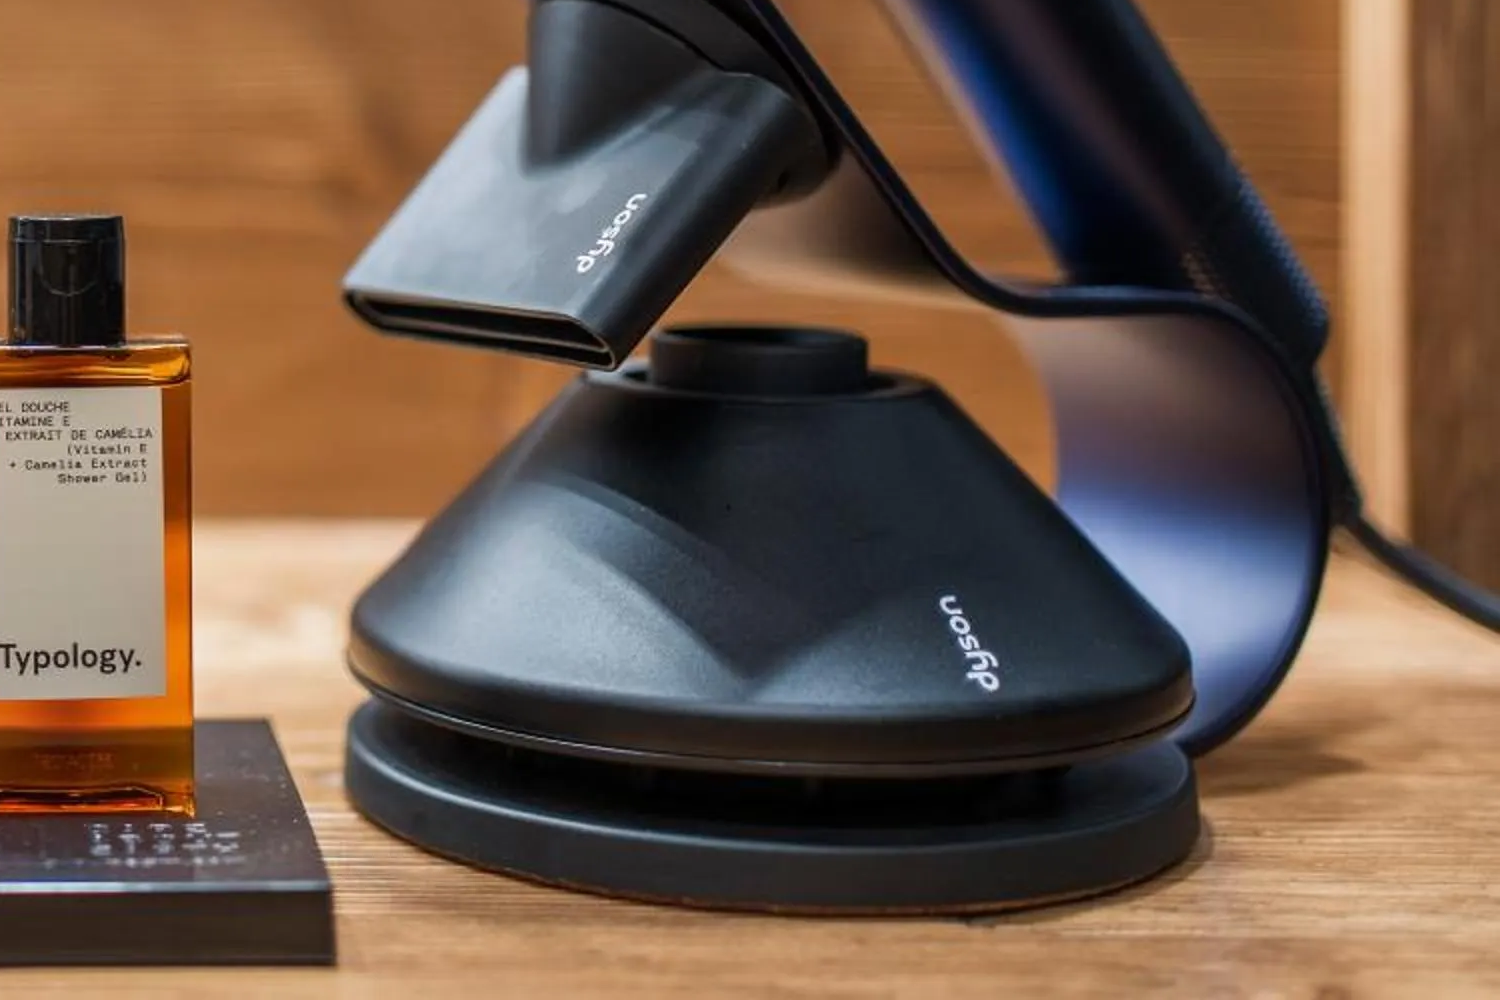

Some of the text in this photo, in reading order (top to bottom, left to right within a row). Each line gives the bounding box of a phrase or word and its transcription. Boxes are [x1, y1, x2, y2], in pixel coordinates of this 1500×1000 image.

[575, 192, 648, 274] dyson
[21, 401, 71, 413] DOUCHE
[63, 416, 71, 427] E
[5, 430, 62, 441] EXTRAIT
[71, 430, 87, 441] DE
[95, 427, 153, 440] CAMÉLIA
[66, 443, 147, 456] (Vitamin E
[24, 459, 83, 471] Camelia
[91, 457, 148, 469] Extract
[57, 471, 148, 485] Shower Gel)
[939, 594, 1000, 692] dyson
